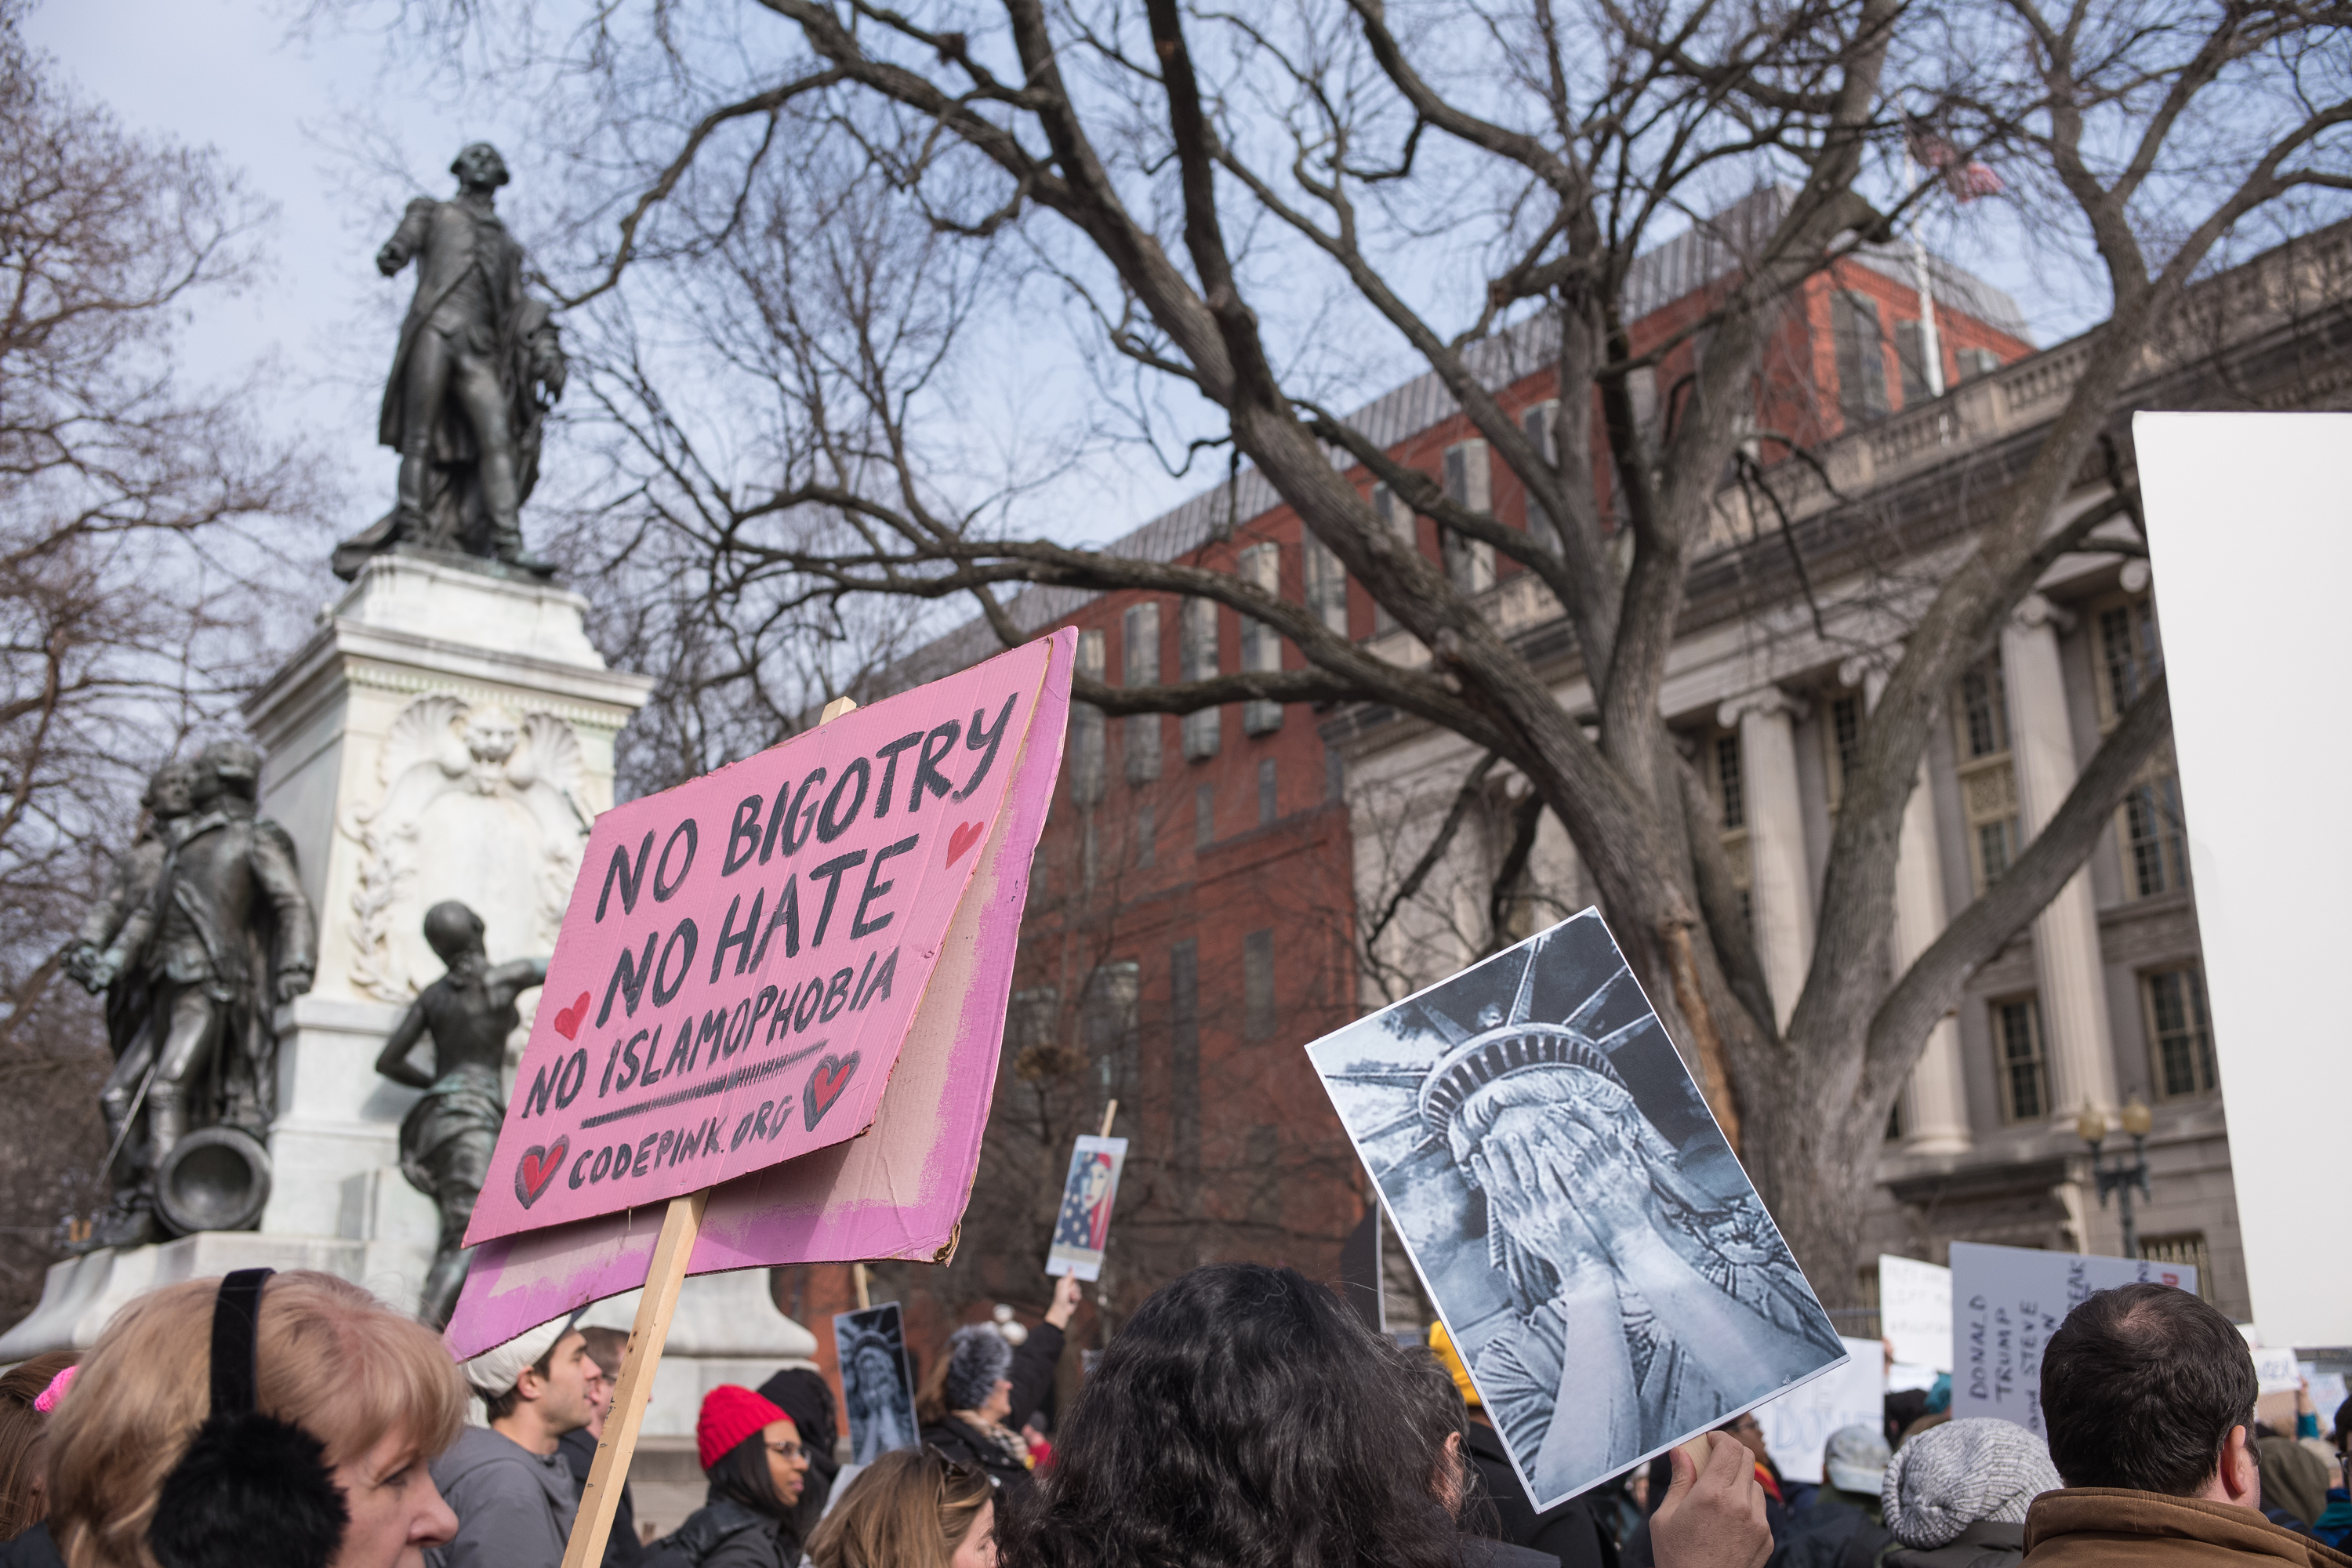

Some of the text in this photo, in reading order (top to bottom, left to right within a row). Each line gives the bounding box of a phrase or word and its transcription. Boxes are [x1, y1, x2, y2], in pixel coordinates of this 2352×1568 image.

[595, 691, 1018, 924] NO BIGOTRY
[595, 833, 920, 1029] NO HATE
[521, 946, 900, 1119] NO ISLAMOPHOBIA
[1969, 1294, 1988, 1400] DONALD
[1994, 1307, 2013, 1403] TRUMP
[2020, 1299, 2038, 1376] STEVE
